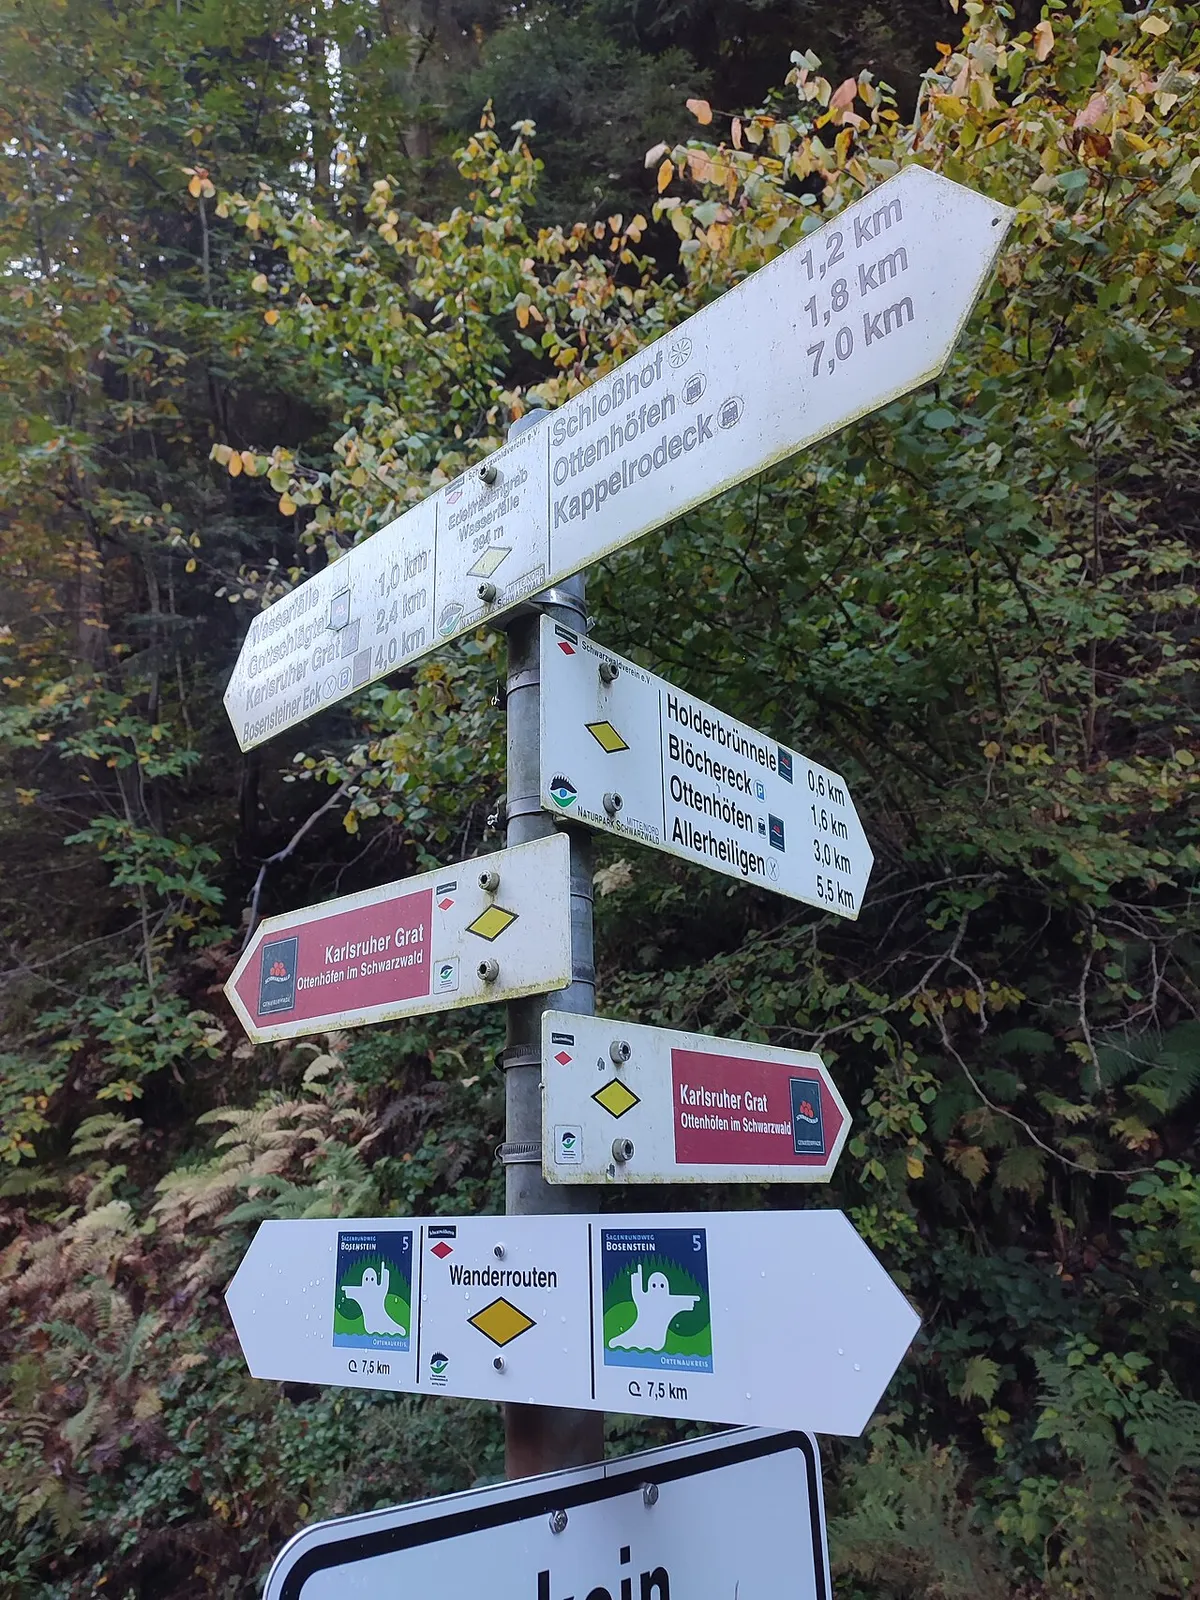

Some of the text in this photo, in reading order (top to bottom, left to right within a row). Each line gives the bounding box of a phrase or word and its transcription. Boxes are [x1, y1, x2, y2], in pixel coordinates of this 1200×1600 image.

[801, 198, 903, 281] 1,2 km
[804, 245, 908, 328] 1,8 km
[807, 294, 914, 378] 7,0 km
[552, 350, 663, 447] Schloßhof
[553, 394, 675, 486] Ottenhöfen
[554, 410, 714, 529] Kappelrodeck
[494, 525, 503, 541] m
[378, 551, 427, 598] 1,0 km
[376, 588, 426, 634] 2,4 km
[312, 636, 340, 671] Grat
[375, 626, 425, 671] 4,0 km
[243, 681, 321, 743] Bosensteiner Eck
[667, 693, 776, 772] Holderbrünnele
[669, 733, 752, 796] Blöchereck
[670, 774, 753, 834] Ottenhöfen
[808, 769, 845, 807] 0,6 km
[811, 804, 848, 841] 1,6 km
[672, 816, 765, 877] Allerheiligen
[813, 839, 851, 875] 3,0 km
[816, 875, 855, 910] 5,5 km
[325, 924, 424, 965] Karlsruher Grat
[297, 949, 423, 990] Ottenhöfen im Schwarzwald
[680, 1084, 768, 1113] Karlsruher Grat
[681, 1114, 792, 1136] Ottenhöfen im Schwarzwald
[341, 1242, 377, 1251] BOSENSTEIN
[402, 1236, 409, 1251] 5
[606, 1241, 656, 1251] BOSENSTEIN
[692, 1235, 702, 1251] 5
[449, 1264, 557, 1288] Wanderrouten
[362, 1360, 390, 1375] 7,5 km
[660, 1356, 709, 1368] ORTENAUKREIS
[647, 1381, 688, 1400] 7,5 km
